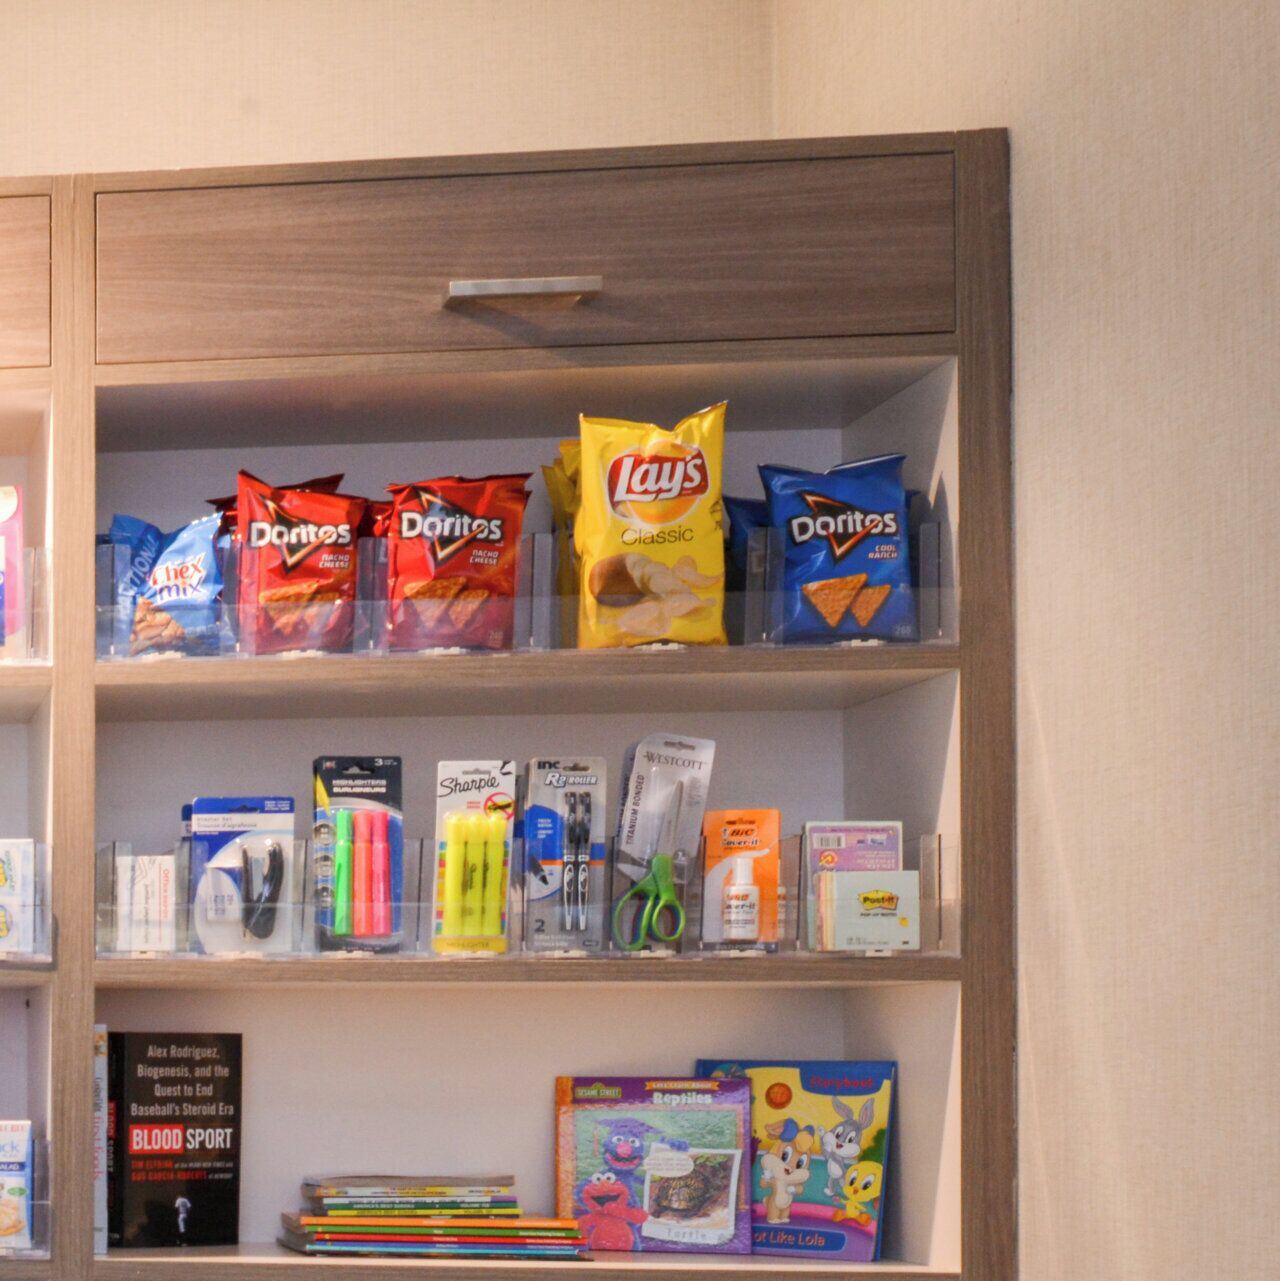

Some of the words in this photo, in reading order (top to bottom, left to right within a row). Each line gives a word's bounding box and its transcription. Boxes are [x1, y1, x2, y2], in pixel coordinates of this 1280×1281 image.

[614, 453, 703, 502] Lay's
[402, 511, 503, 539] Doritos
[791, 511, 898, 544] Doritos
[250, 521, 352, 547] Doritos
[621, 527, 694, 545] Classic
[321, 553, 349, 561] NACHO
[470, 556, 498, 566] CHEESE
[473, 549, 499, 558] NACHO
[868, 551, 897, 559] RANCH
[645, 751, 703, 770] WESTCOTT
[439, 777, 500, 798] Sharpie
[626, 801, 640, 846] TITANIUM
[634, 774, 646, 800] BONDED
[863, 896, 895, 904] Post-it
[534, 919, 546, 932] 2
[147, 1045, 167, 1058] Alex
[170, 1045, 220, 1059] Rodriguez,
[137, 1064, 191, 1079] Biogenesis,
[194, 1064, 211, 1077] and
[215, 1064, 229, 1077] the
[154, 1083, 181, 1098] Quest
[183, 1084, 193, 1096] to
[196, 1083, 213, 1096] End
[653, 1093, 712, 1105] Reptiles
[131, 1103, 180, 1116] Baseball's
[182, 1102, 216, 1116] Steroid
[218, 1103, 234, 1116] Era
[133, 1129, 182, 1150] BLOOD
[186, 1128, 232, 1149] SPORT
[769, 1233, 794, 1245] Like
[798, 1233, 826, 1247] Lola
